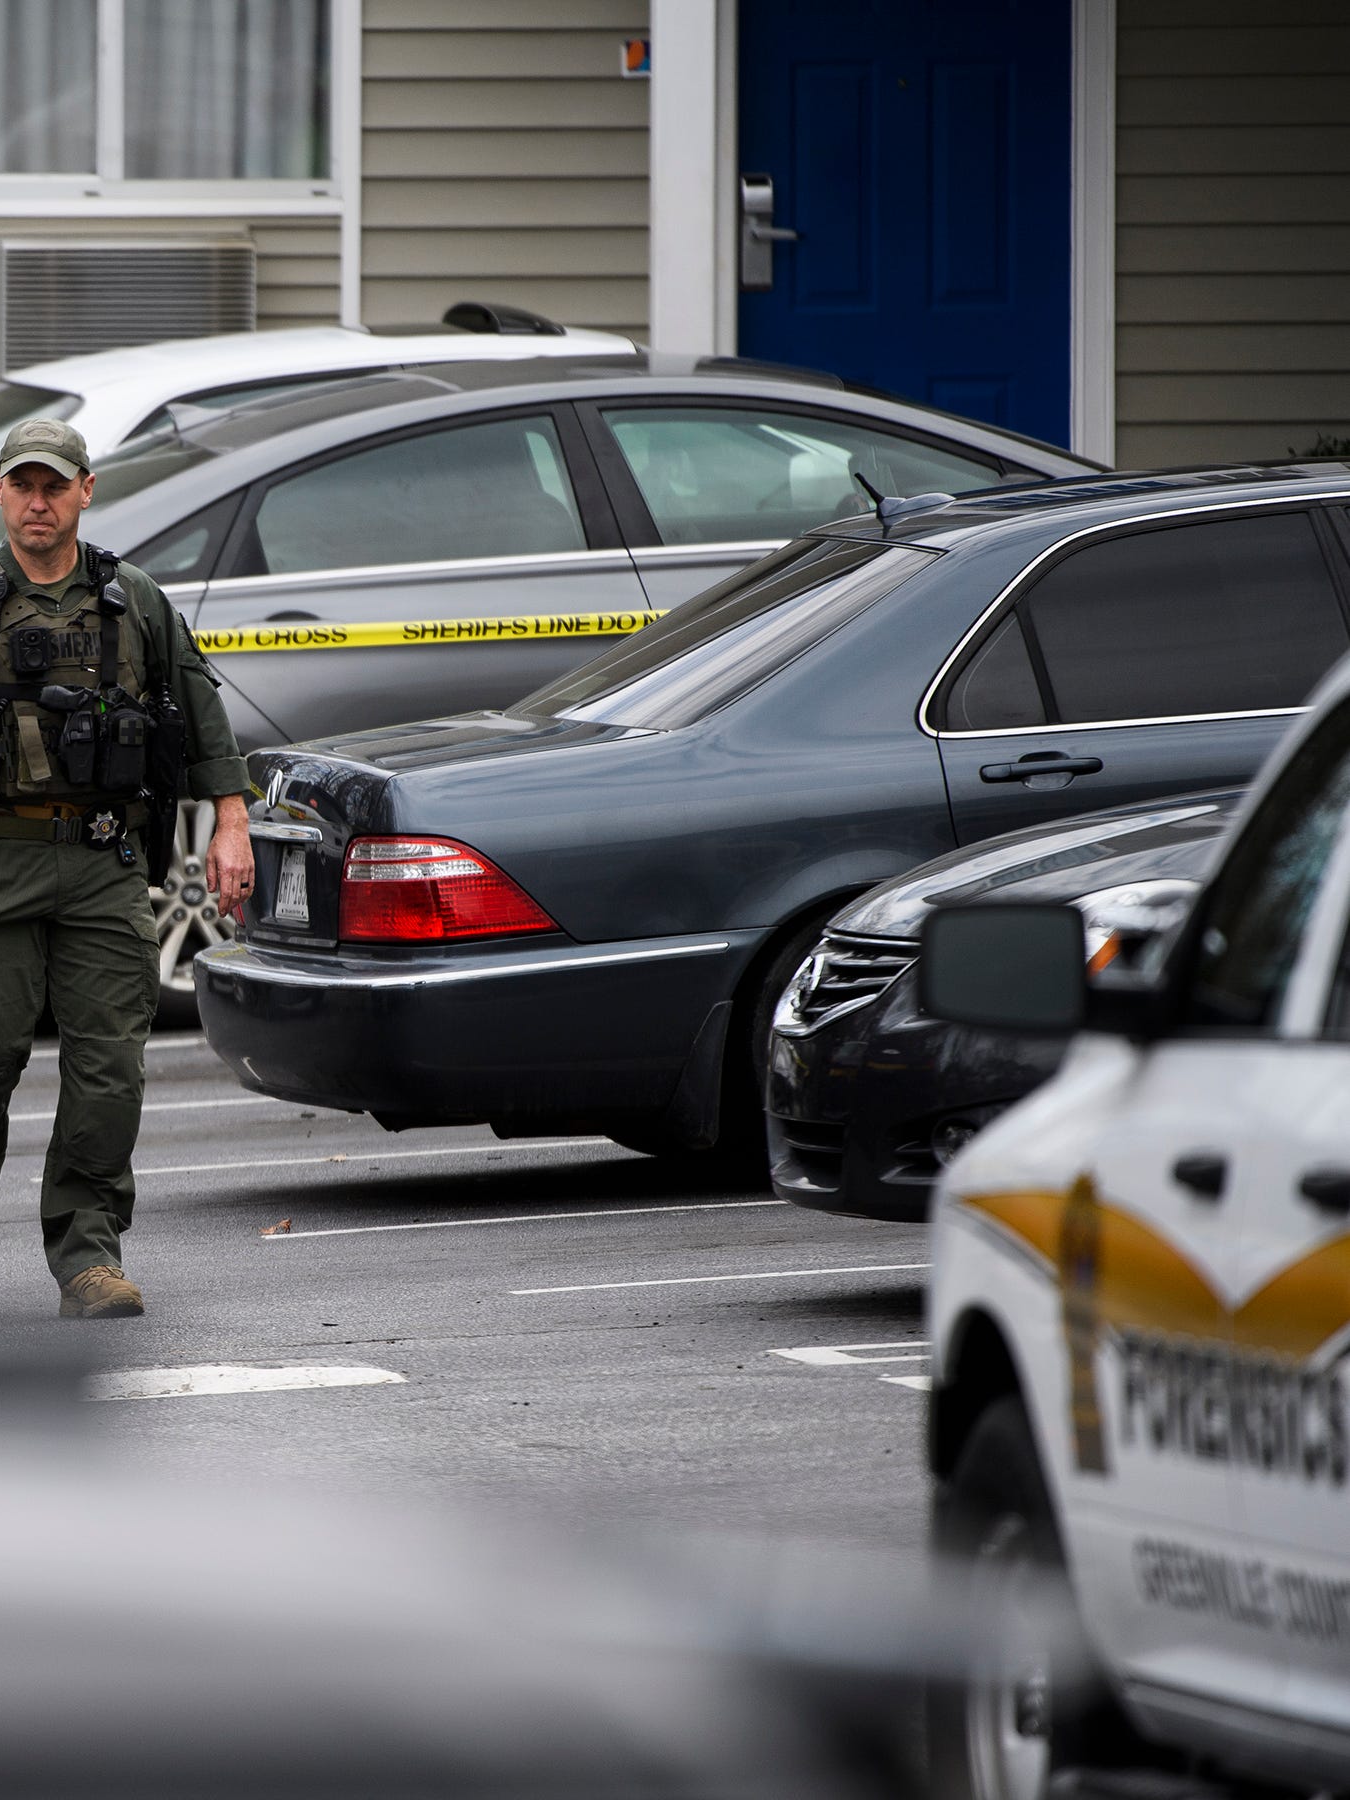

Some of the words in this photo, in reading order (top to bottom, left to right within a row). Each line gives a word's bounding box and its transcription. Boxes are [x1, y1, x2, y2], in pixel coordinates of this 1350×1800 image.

[197, 631, 245, 648] NOT
[255, 627, 348, 646] CROSS
[402, 618, 529, 640] SHERIFFS
[534, 614, 591, 634] LINE
[598, 612, 637, 631] DO
